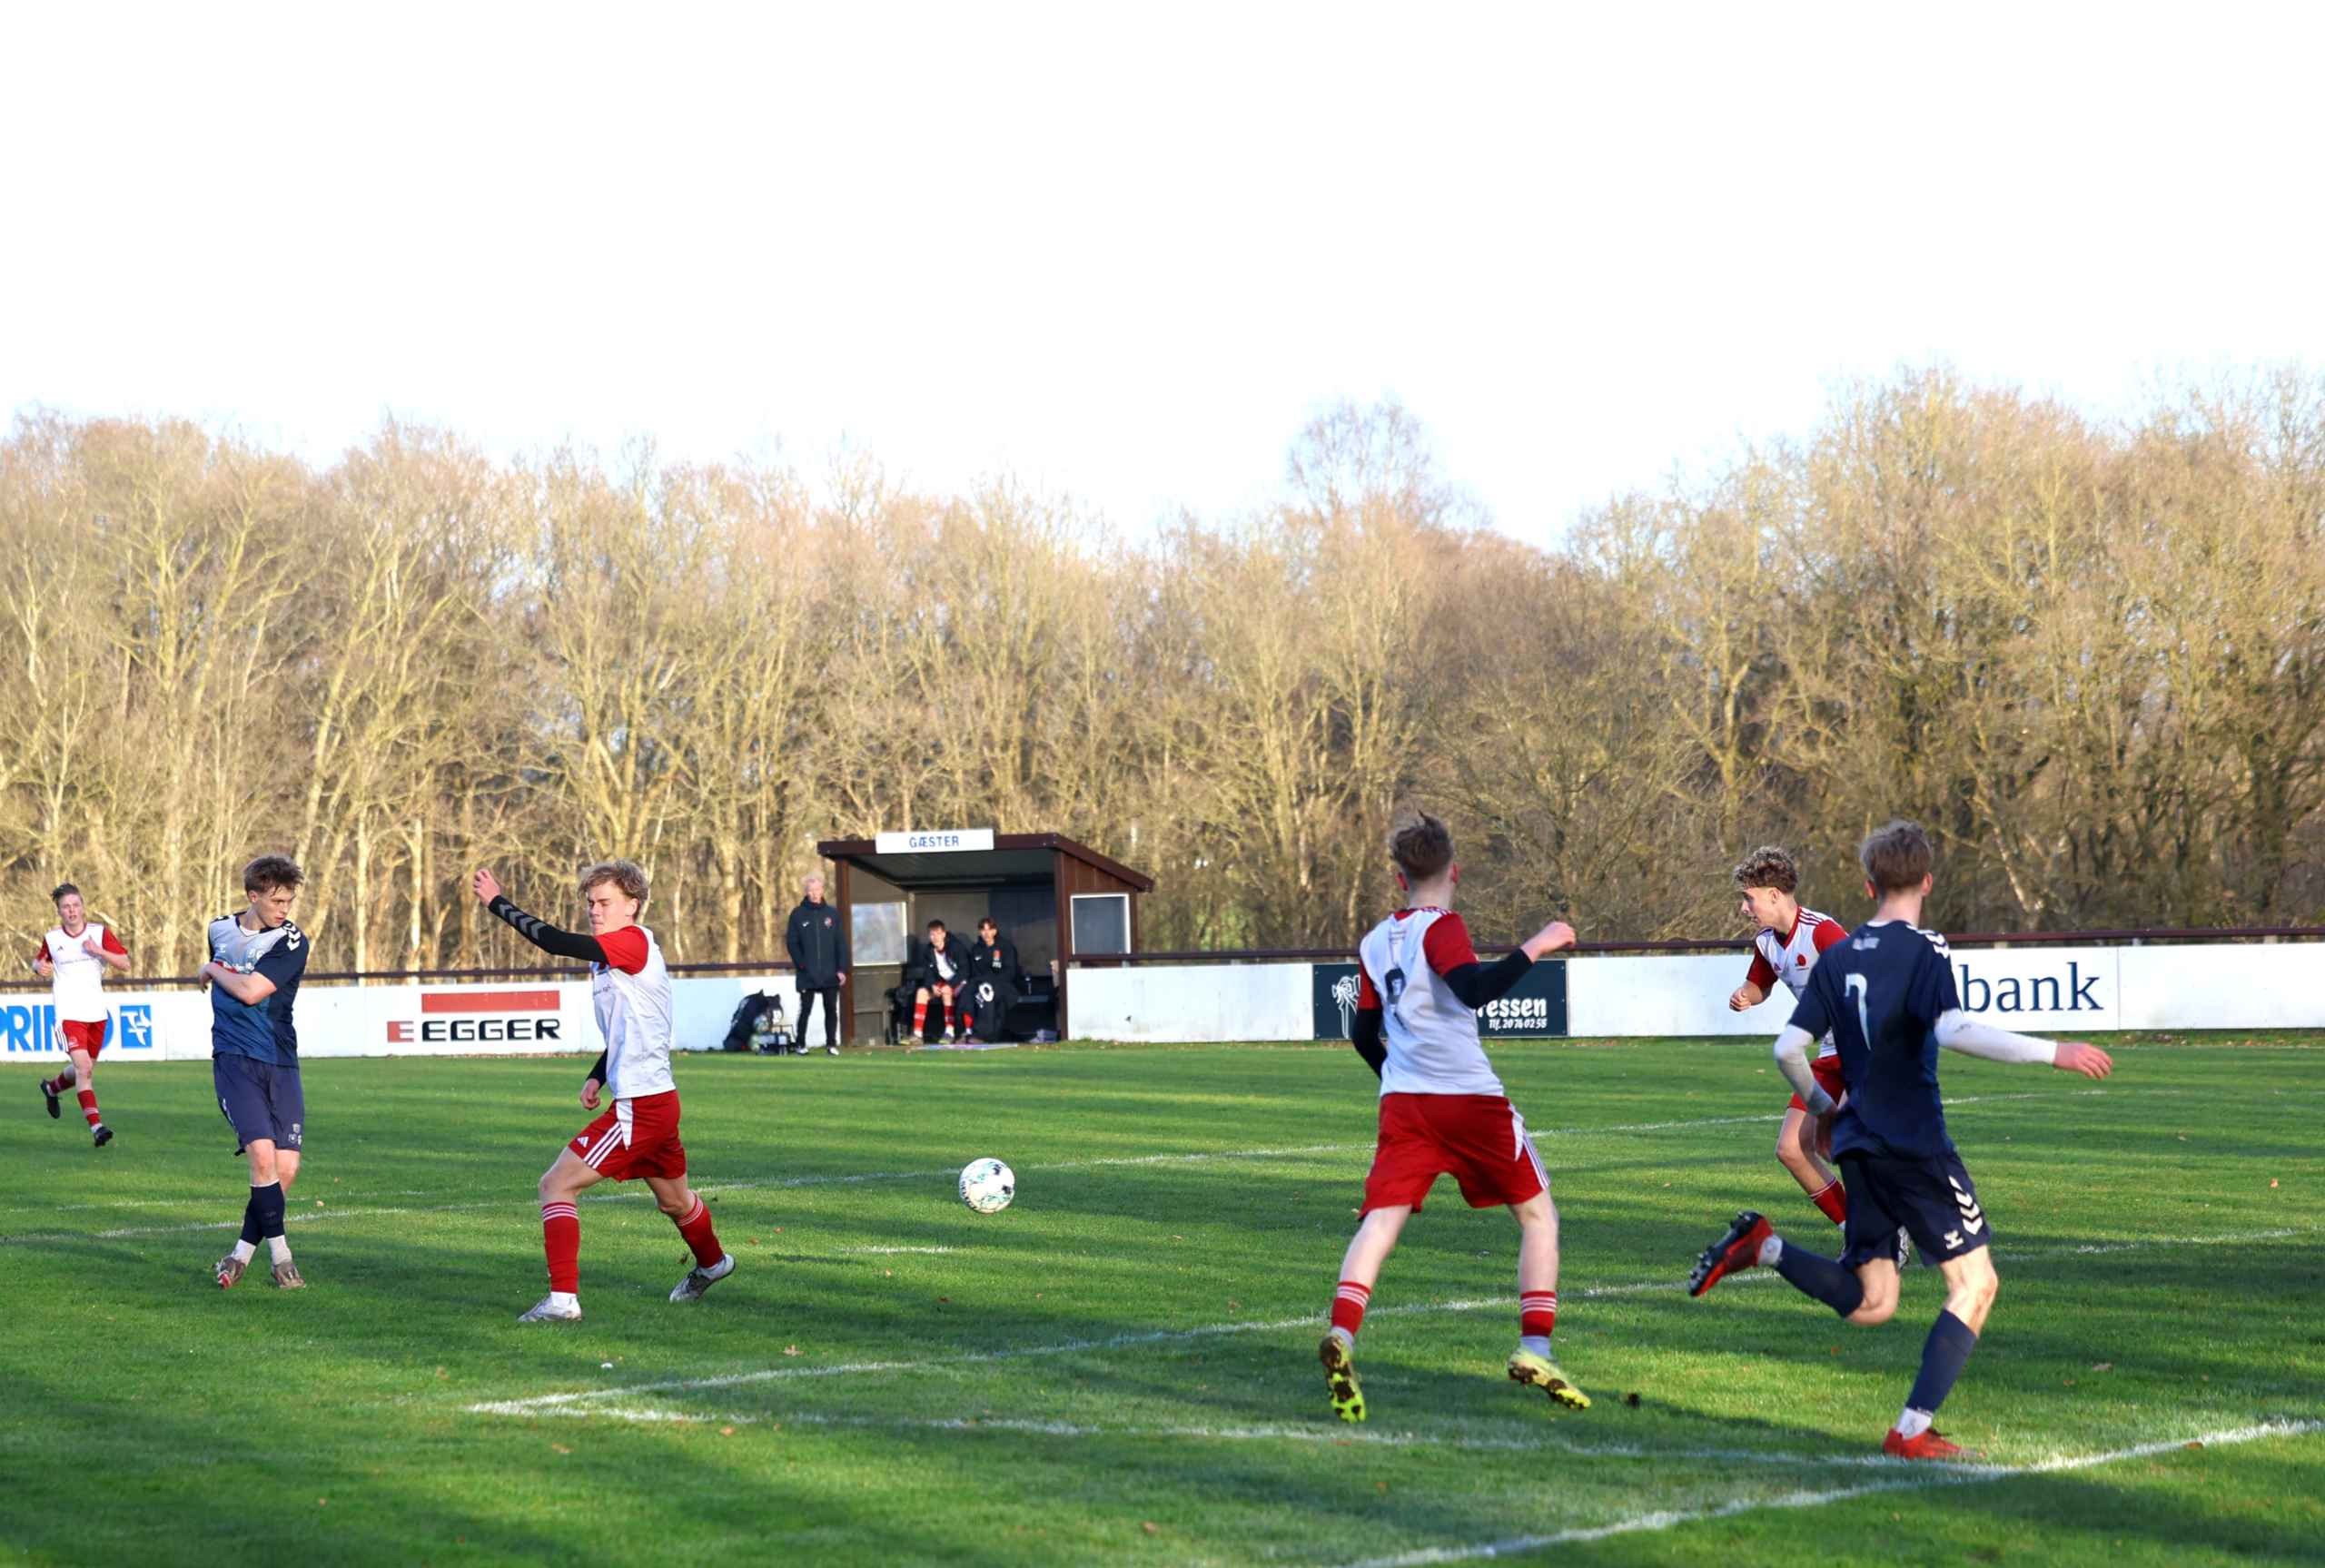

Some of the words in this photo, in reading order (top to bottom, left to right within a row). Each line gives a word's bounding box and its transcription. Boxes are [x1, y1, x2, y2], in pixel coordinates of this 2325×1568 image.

[909, 835, 959, 848] GÆSTER
[1958, 962, 2104, 1013] bank
[1845, 972, 1871, 1050] 7
[421, 1019, 561, 1041] EGGER
